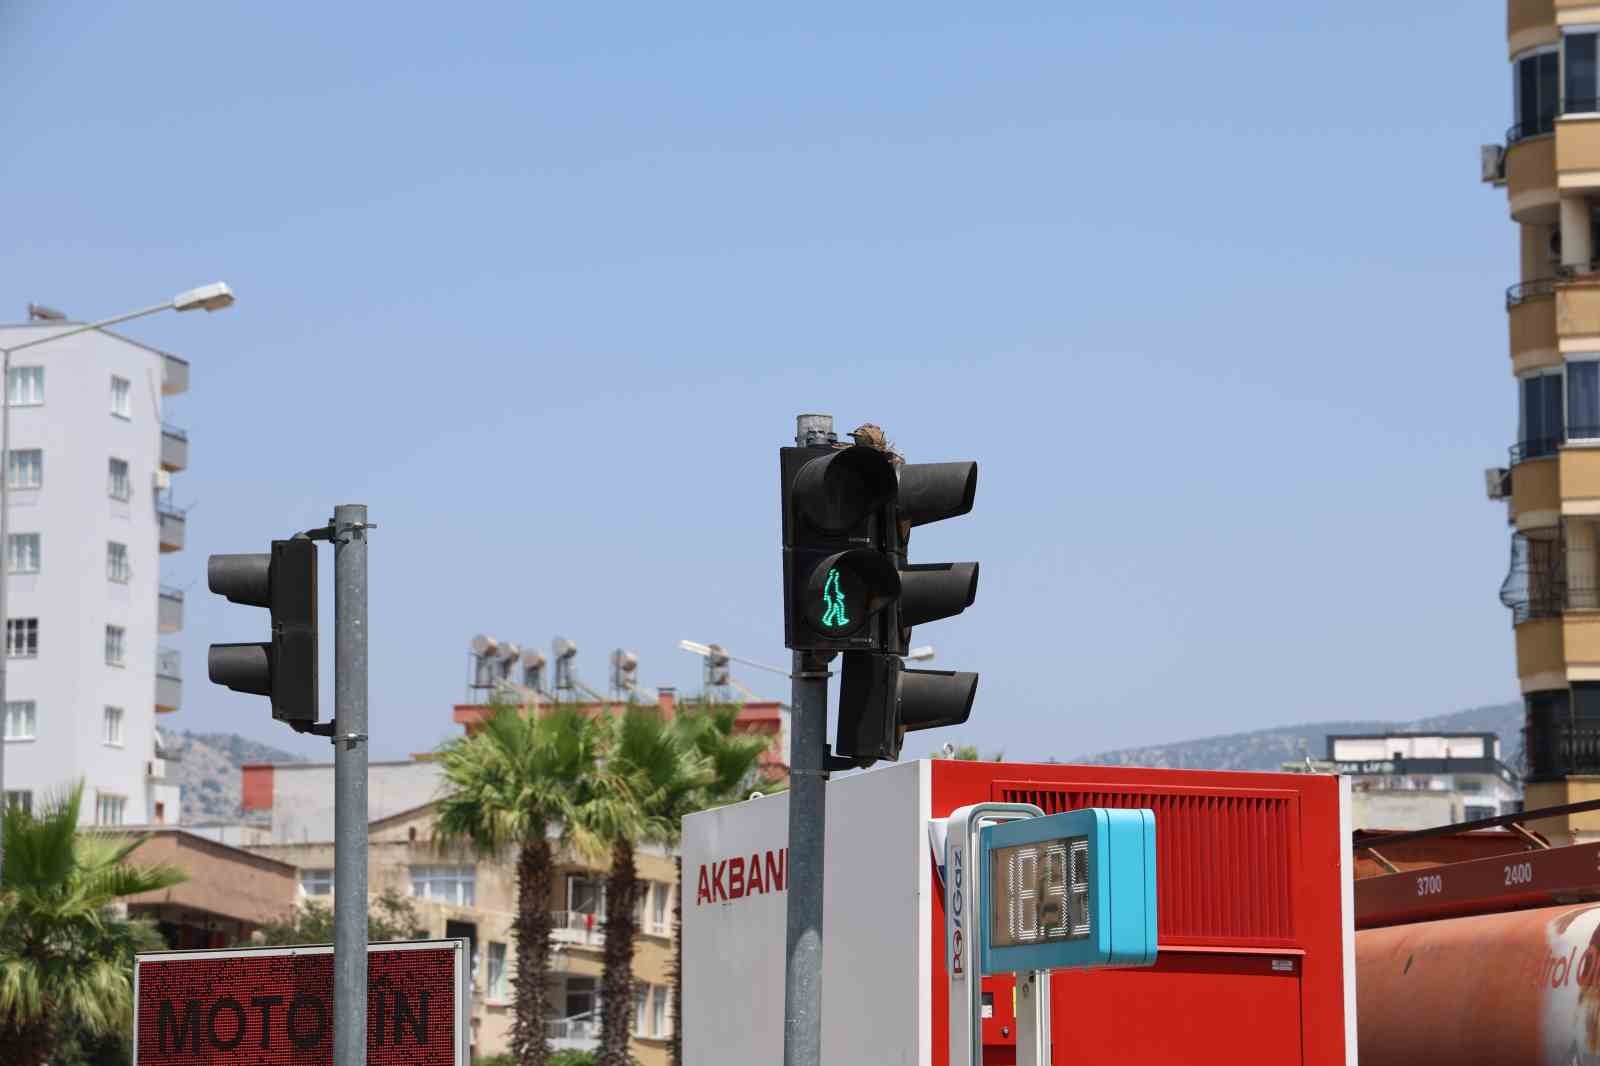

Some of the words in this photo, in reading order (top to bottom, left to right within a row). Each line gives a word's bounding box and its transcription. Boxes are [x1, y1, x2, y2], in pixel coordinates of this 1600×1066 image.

[696, 847, 789, 906] AKBAN
[1416, 874, 1442, 897] 3700
[1504, 863, 1532, 886] 2400
